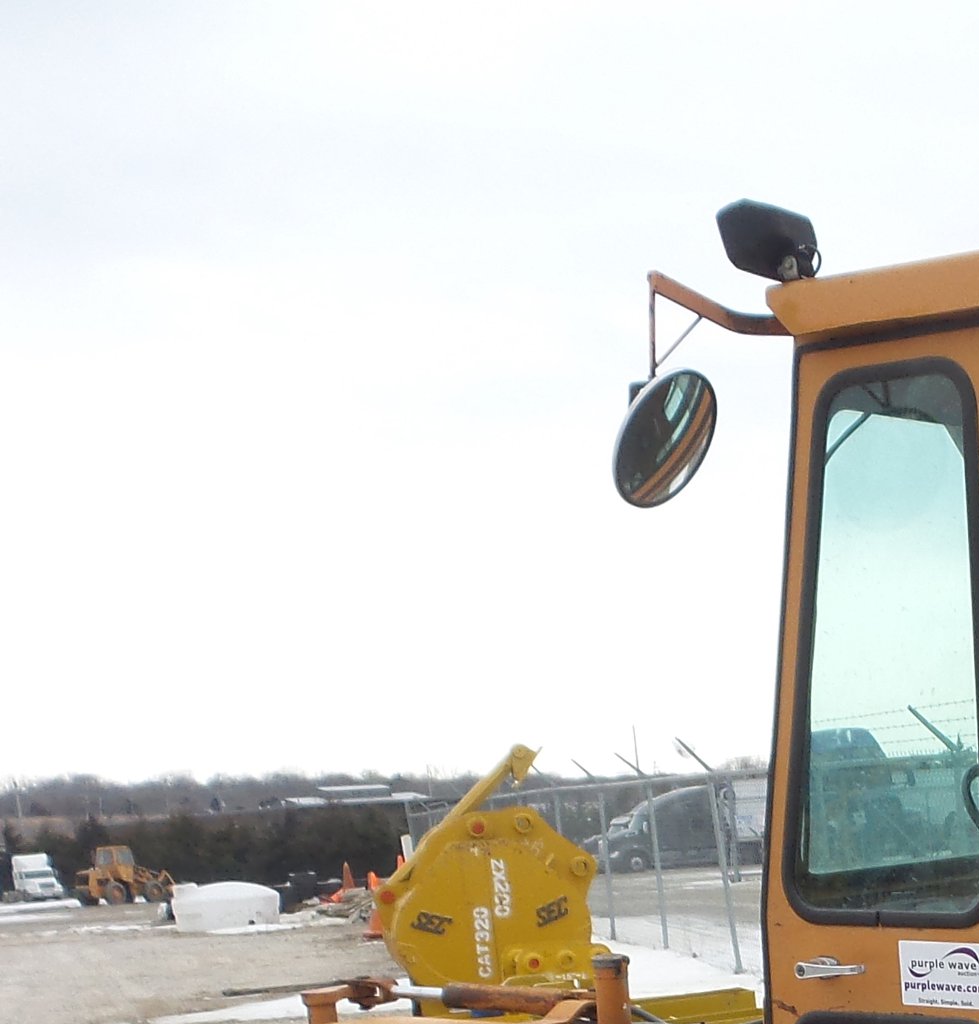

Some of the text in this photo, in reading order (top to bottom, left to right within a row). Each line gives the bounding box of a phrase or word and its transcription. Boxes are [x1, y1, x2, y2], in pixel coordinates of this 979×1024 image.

[473, 907, 492, 978] CAT 320
[911, 959, 977, 971] purple wave
